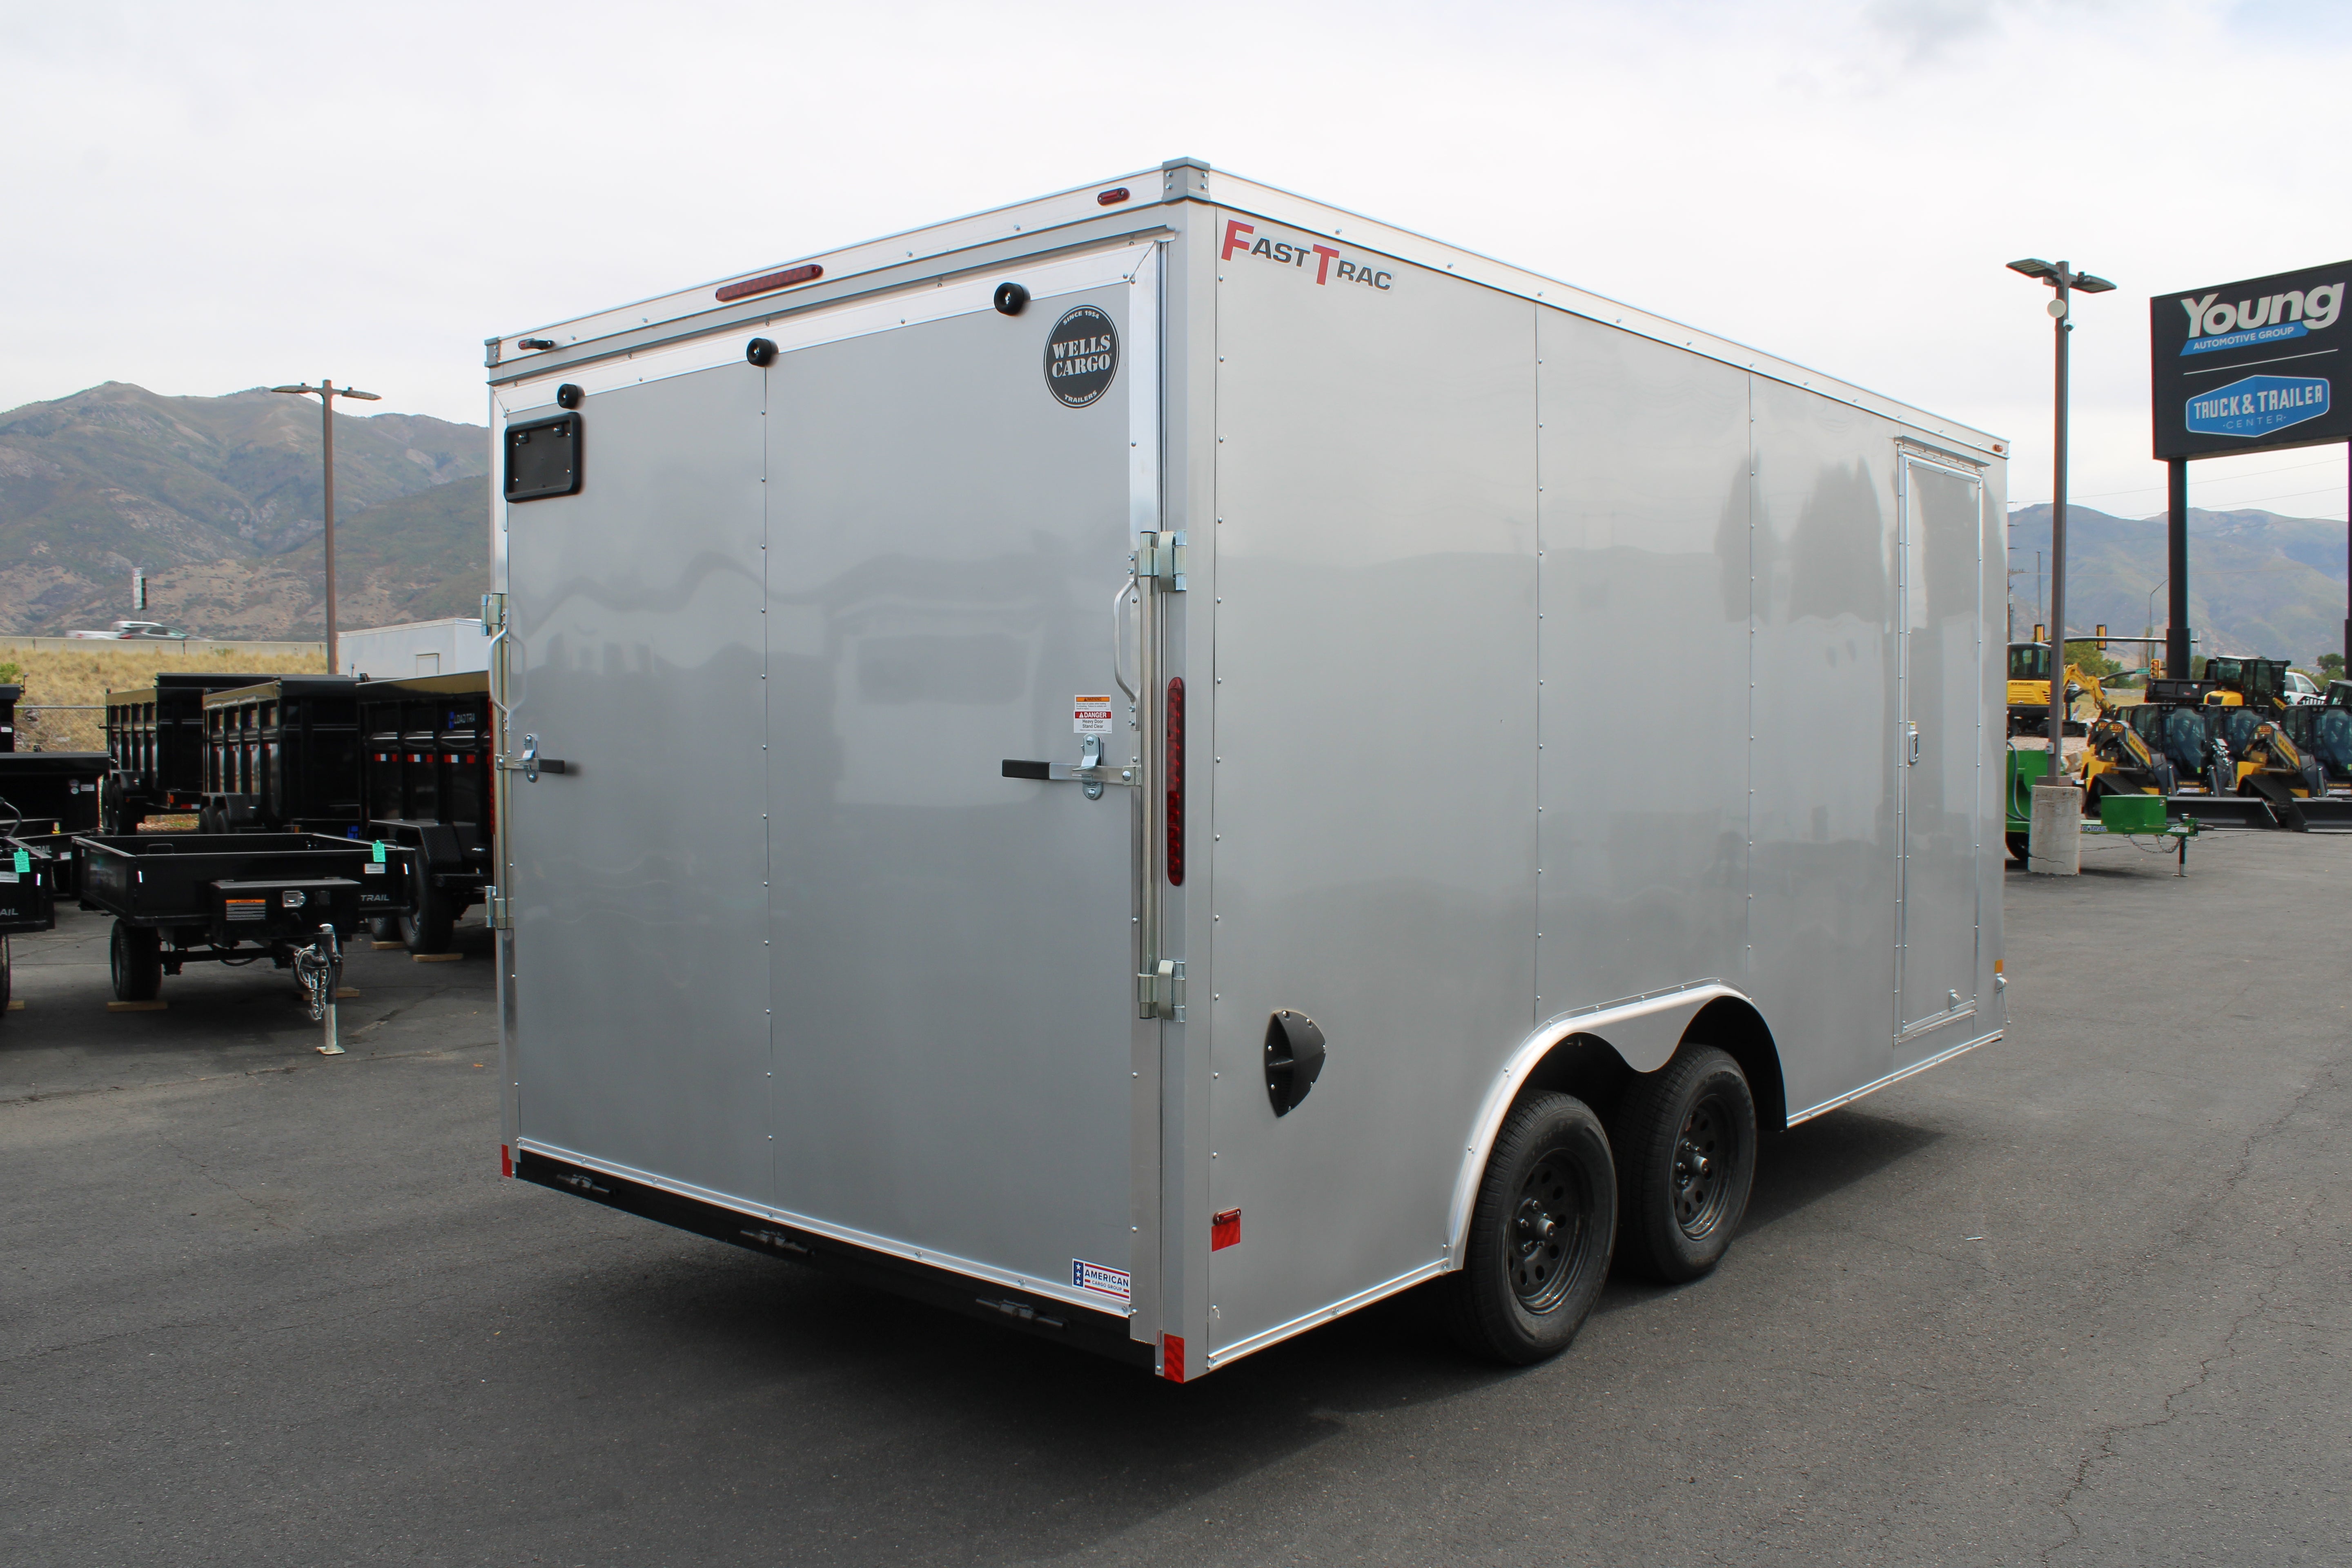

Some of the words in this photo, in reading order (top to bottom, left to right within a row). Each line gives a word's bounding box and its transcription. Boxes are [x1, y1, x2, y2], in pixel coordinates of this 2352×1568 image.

[1063, 310, 1082, 325] SINCE
[1085, 310, 1099, 319] 1954
[2180, 282, 2345, 338] Young
[1052, 334, 1111, 359] WELLS
[2193, 333, 2256, 350] AUTOMOTIVE
[2258, 326, 2294, 339] GROUP
[1052, 354, 1111, 378] CARGO
[1064, 390, 1097, 403] TRAILERS
[2194, 395, 2239, 419] TRUCK
[2242, 394, 2255, 414] &
[2257, 384, 2323, 412] TRAILER
[1085, 1269, 1129, 1287] AMERICAN
